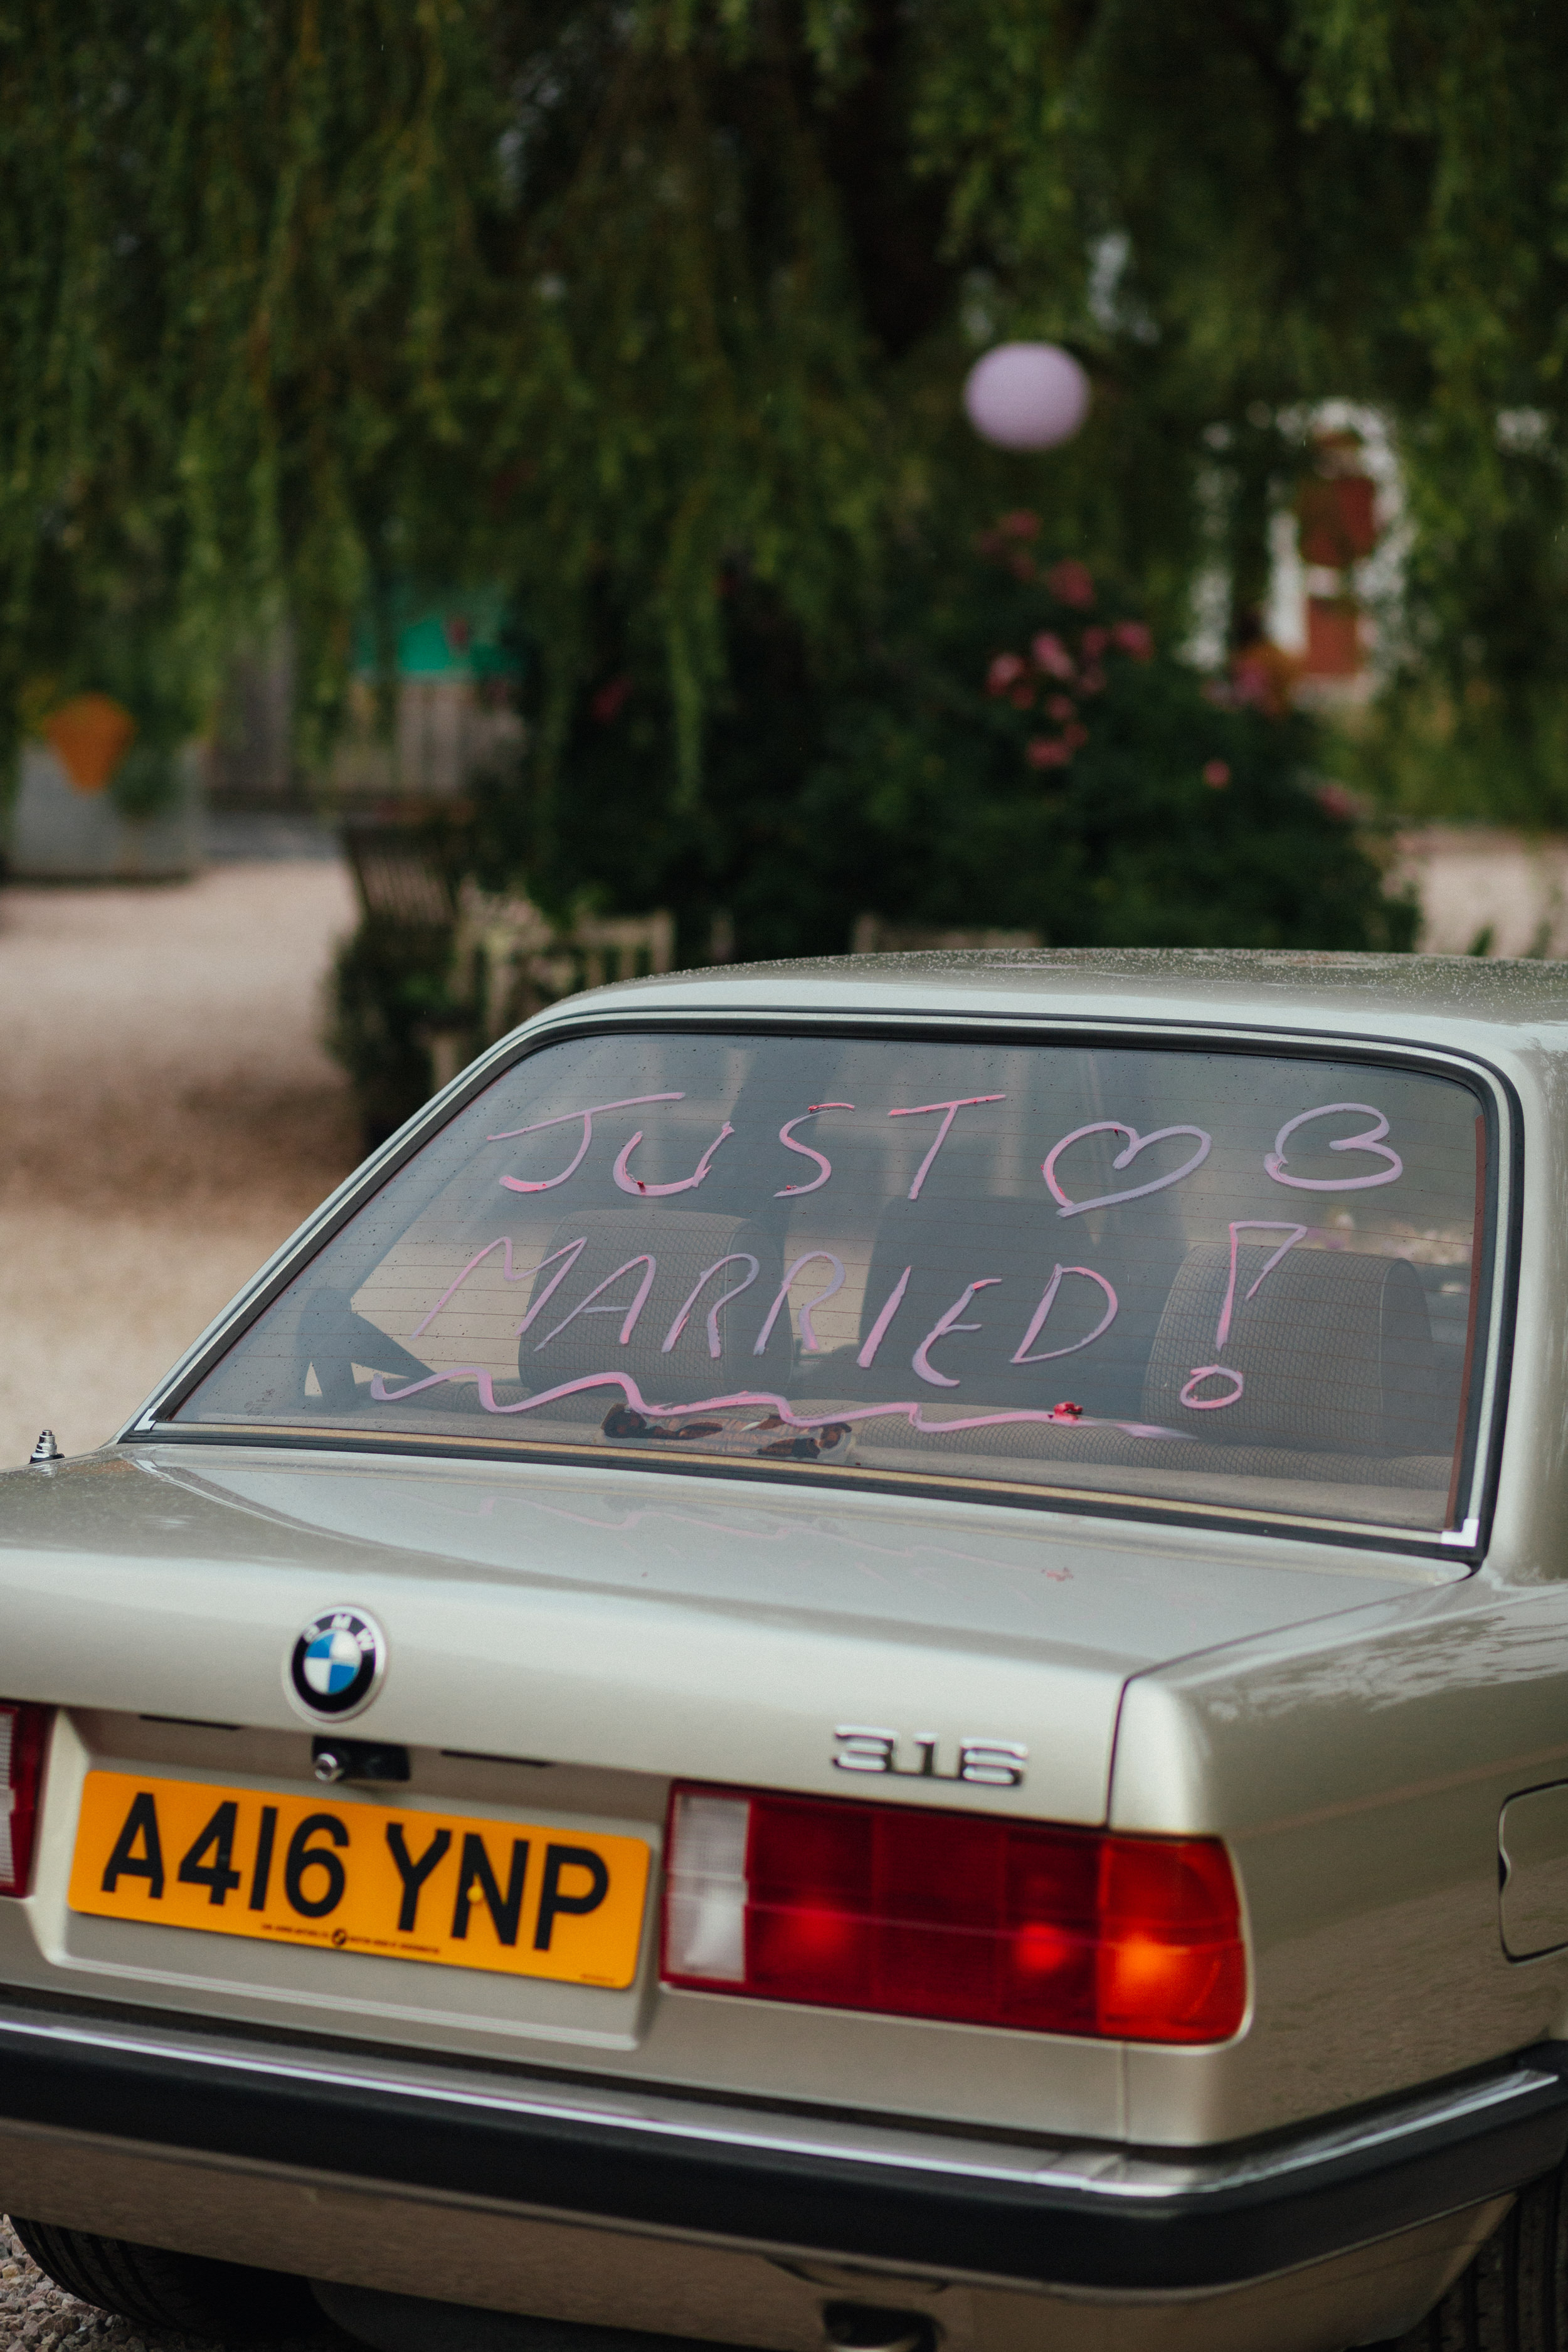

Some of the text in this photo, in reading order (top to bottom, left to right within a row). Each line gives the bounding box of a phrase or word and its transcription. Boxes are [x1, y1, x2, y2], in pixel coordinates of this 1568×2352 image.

[485, 1091, 1007, 1200] JUST
[303, 1614, 376, 1651] BMW
[832, 1725, 1027, 1786] 316
[102, 1791, 610, 1952] A416 YNP
